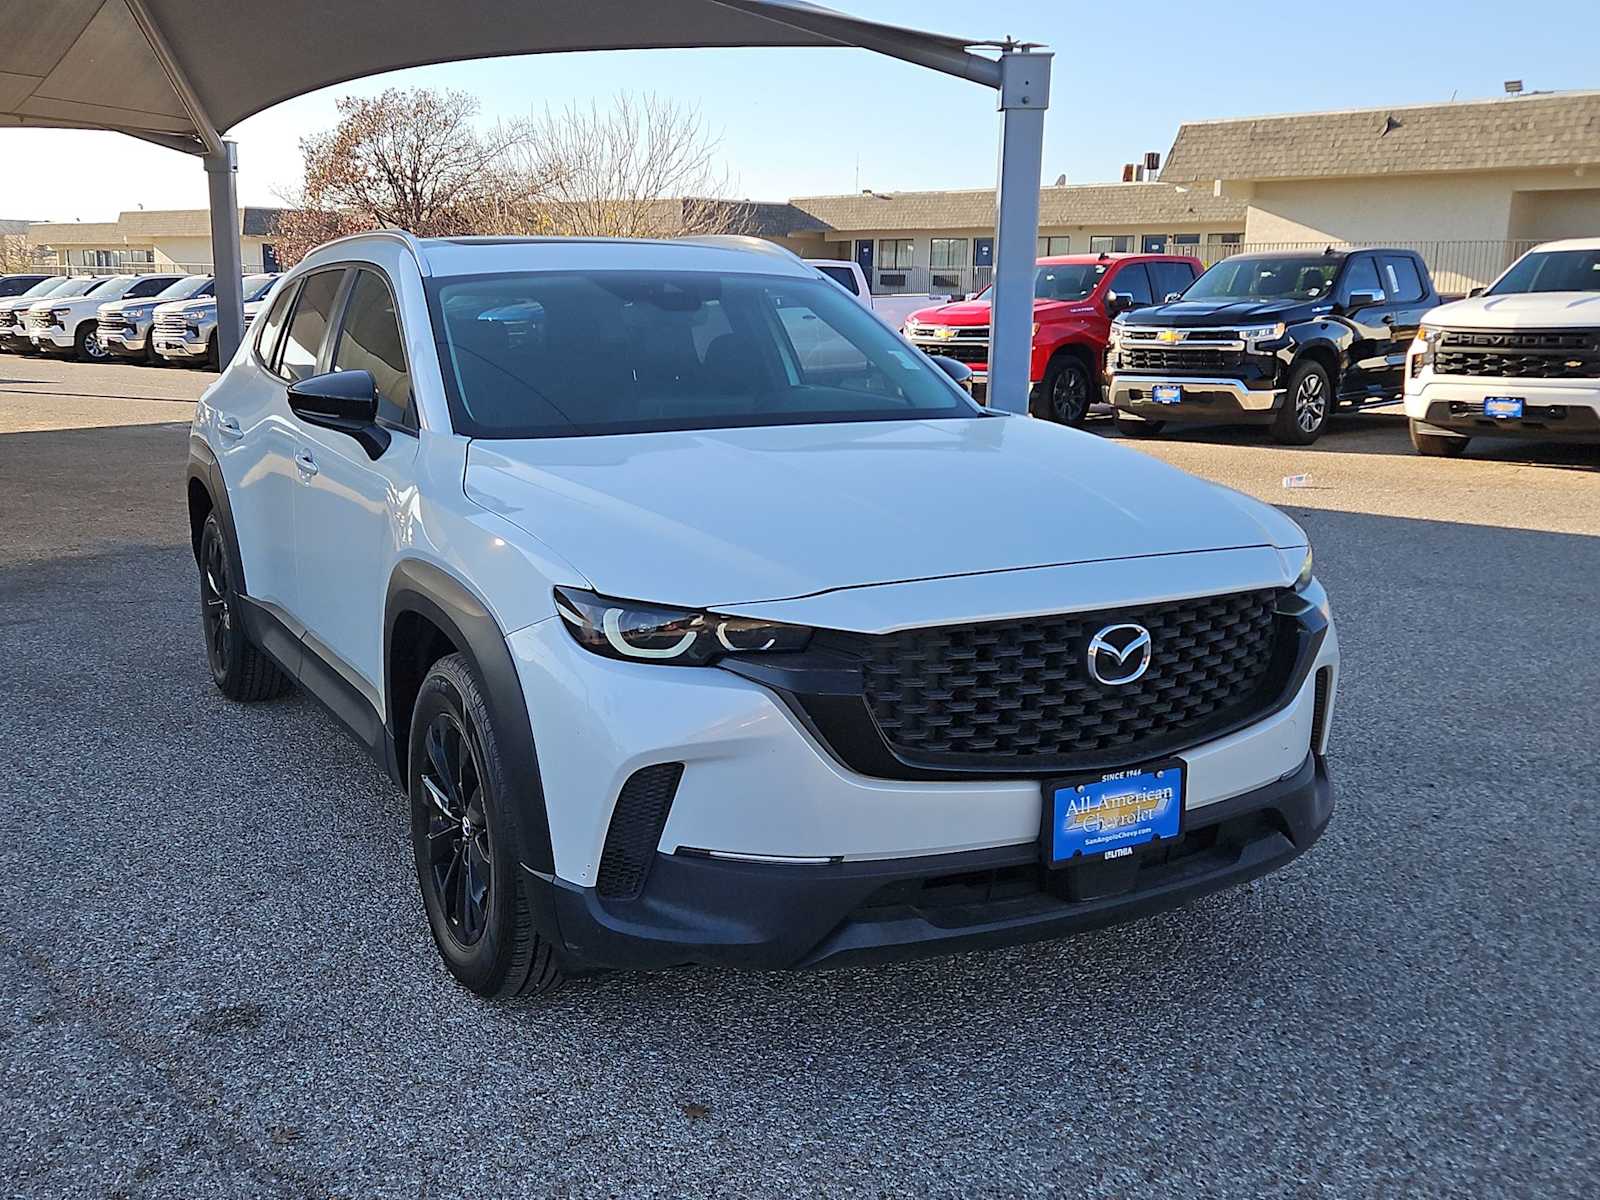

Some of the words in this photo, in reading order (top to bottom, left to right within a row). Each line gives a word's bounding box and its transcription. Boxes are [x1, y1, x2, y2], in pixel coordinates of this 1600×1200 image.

[1101, 771, 1125, 782] SINCE
[1065, 795, 1091, 817] All
[1098, 787, 1173, 811] American
[1082, 806, 1154, 833] Chevrolet
